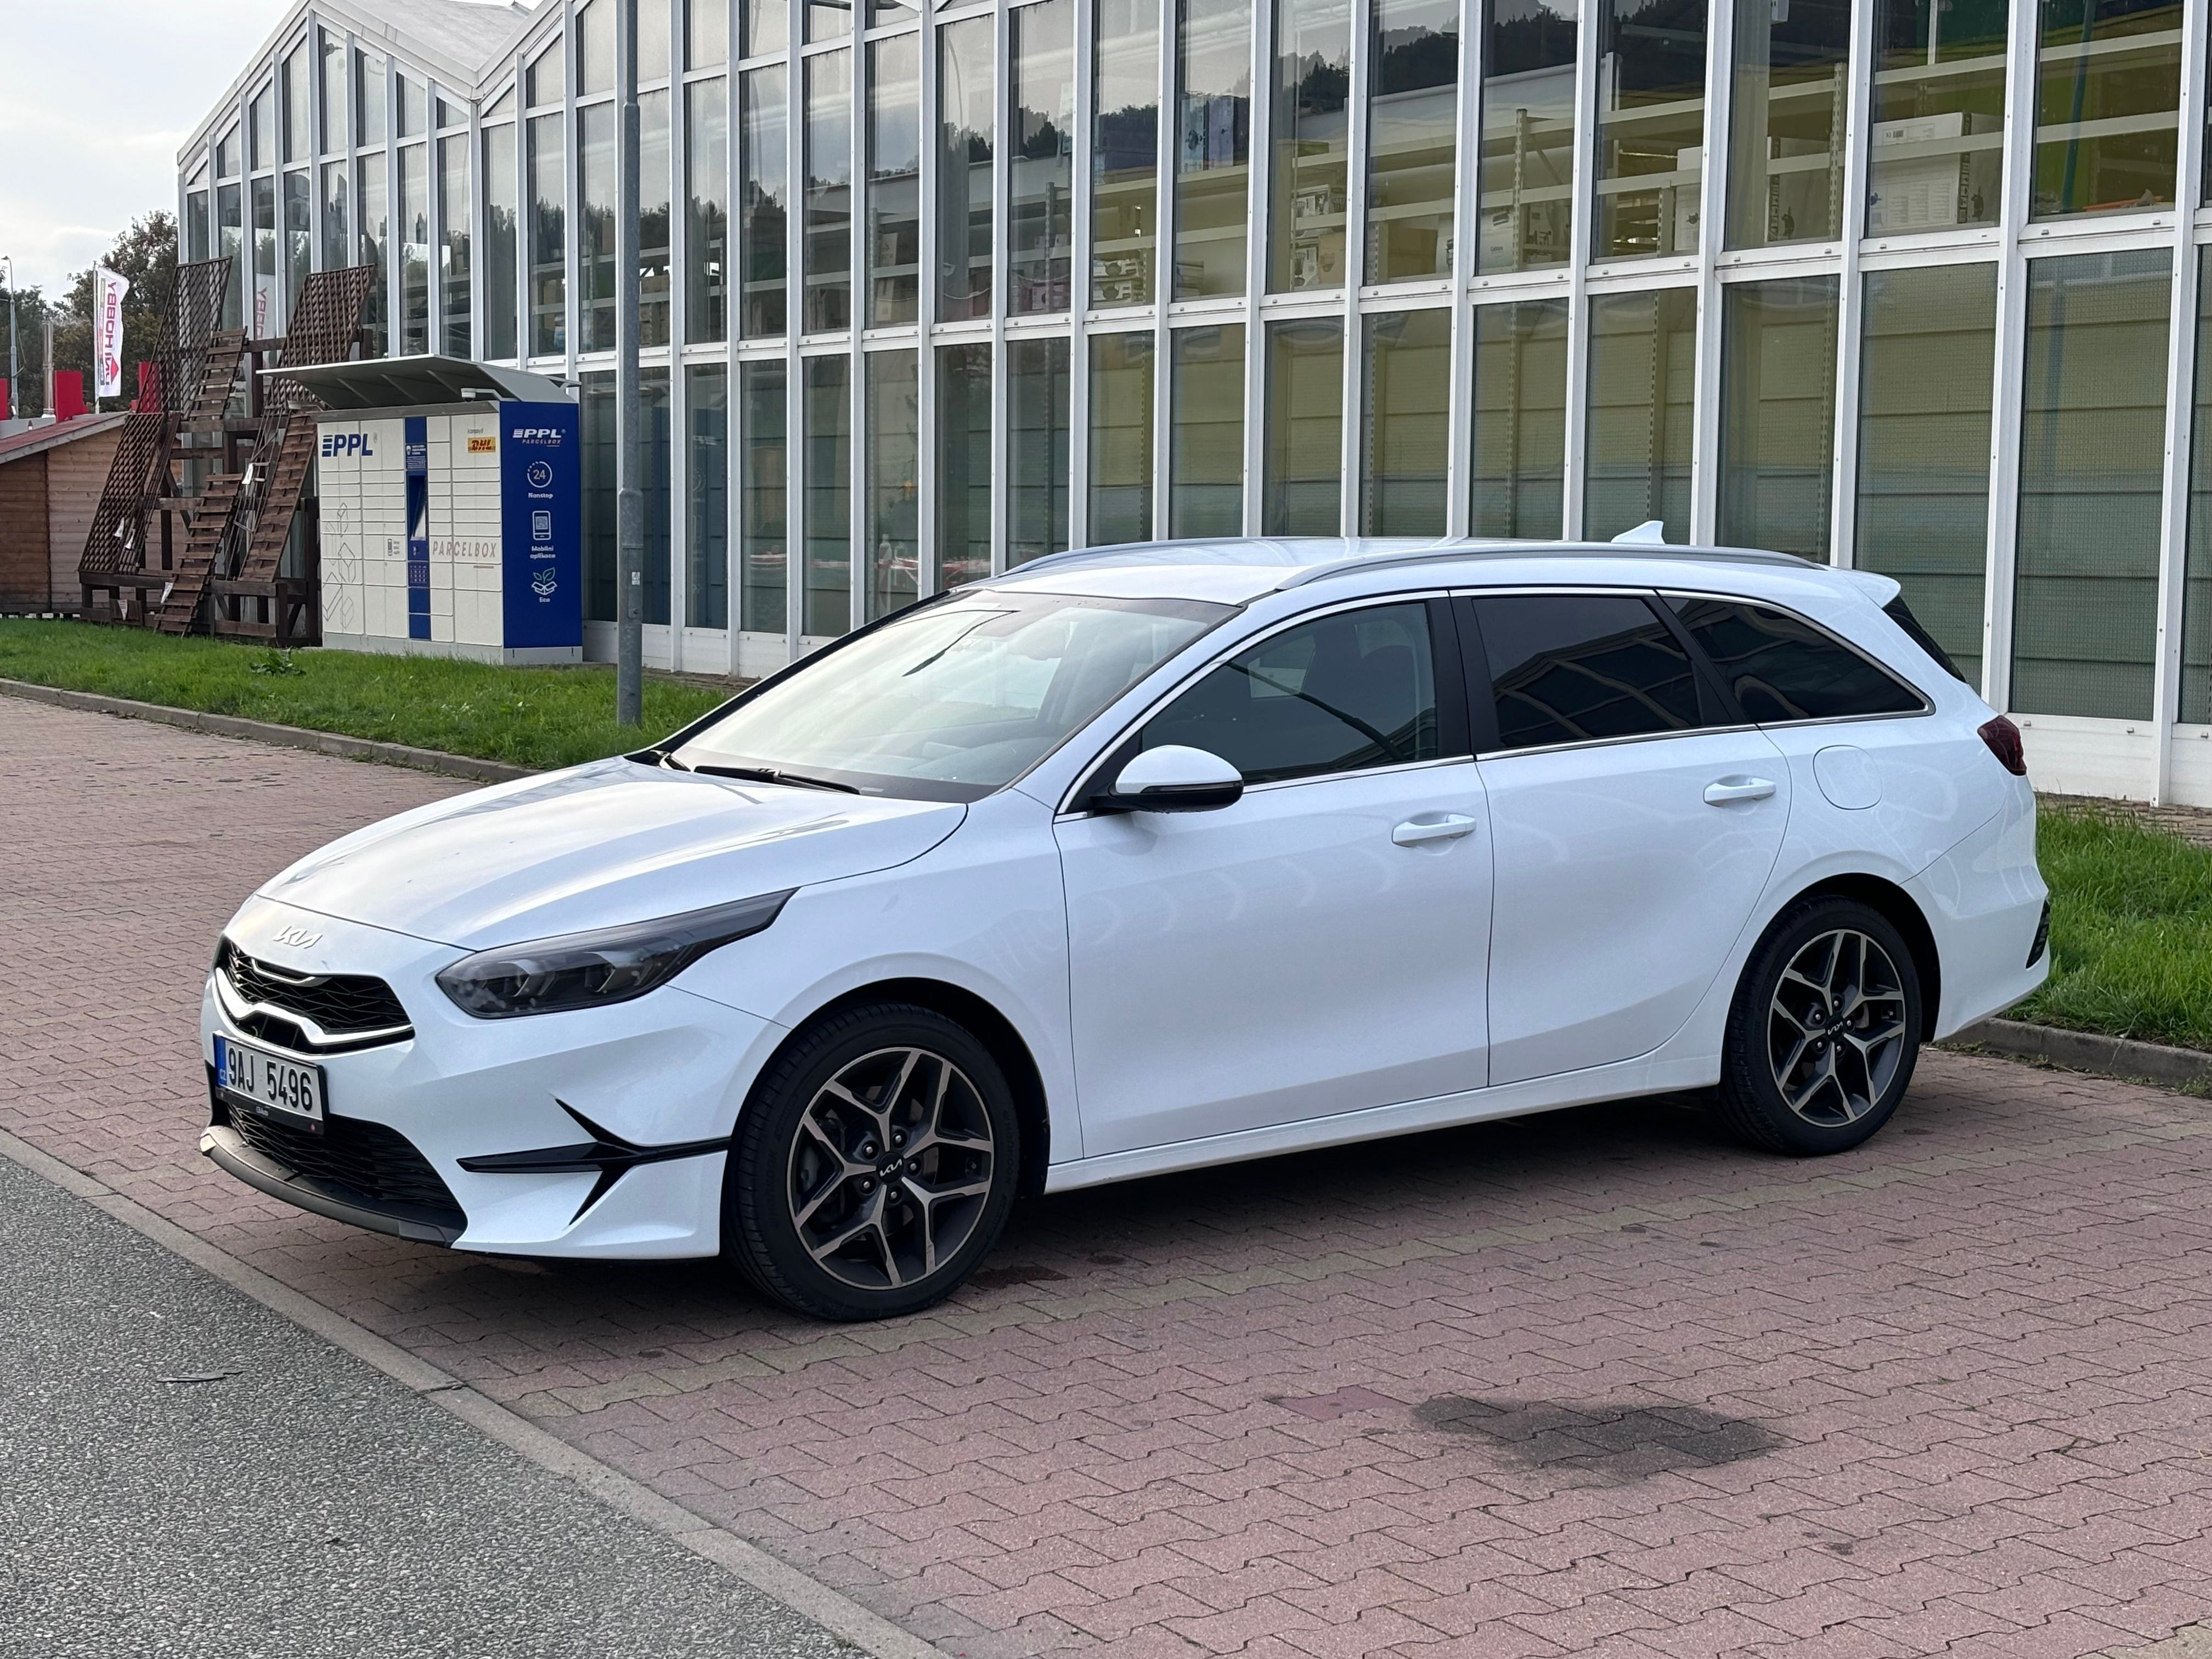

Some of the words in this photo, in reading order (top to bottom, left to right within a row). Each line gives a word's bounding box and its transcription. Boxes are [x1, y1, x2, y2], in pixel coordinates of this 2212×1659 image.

[524, 428, 562, 438] PPL
[333, 433, 373, 456] PPL
[471, 439, 492, 450] DHL
[533, 470, 546, 479] 24
[433, 540, 497, 557] PARCELBOX
[272, 924, 323, 949] KIA
[219, 1069, 226, 1080] CZ
[229, 1047, 254, 1092] 9AJ
[267, 1060, 313, 1111] 5496
[880, 1159, 902, 1177] KIA
